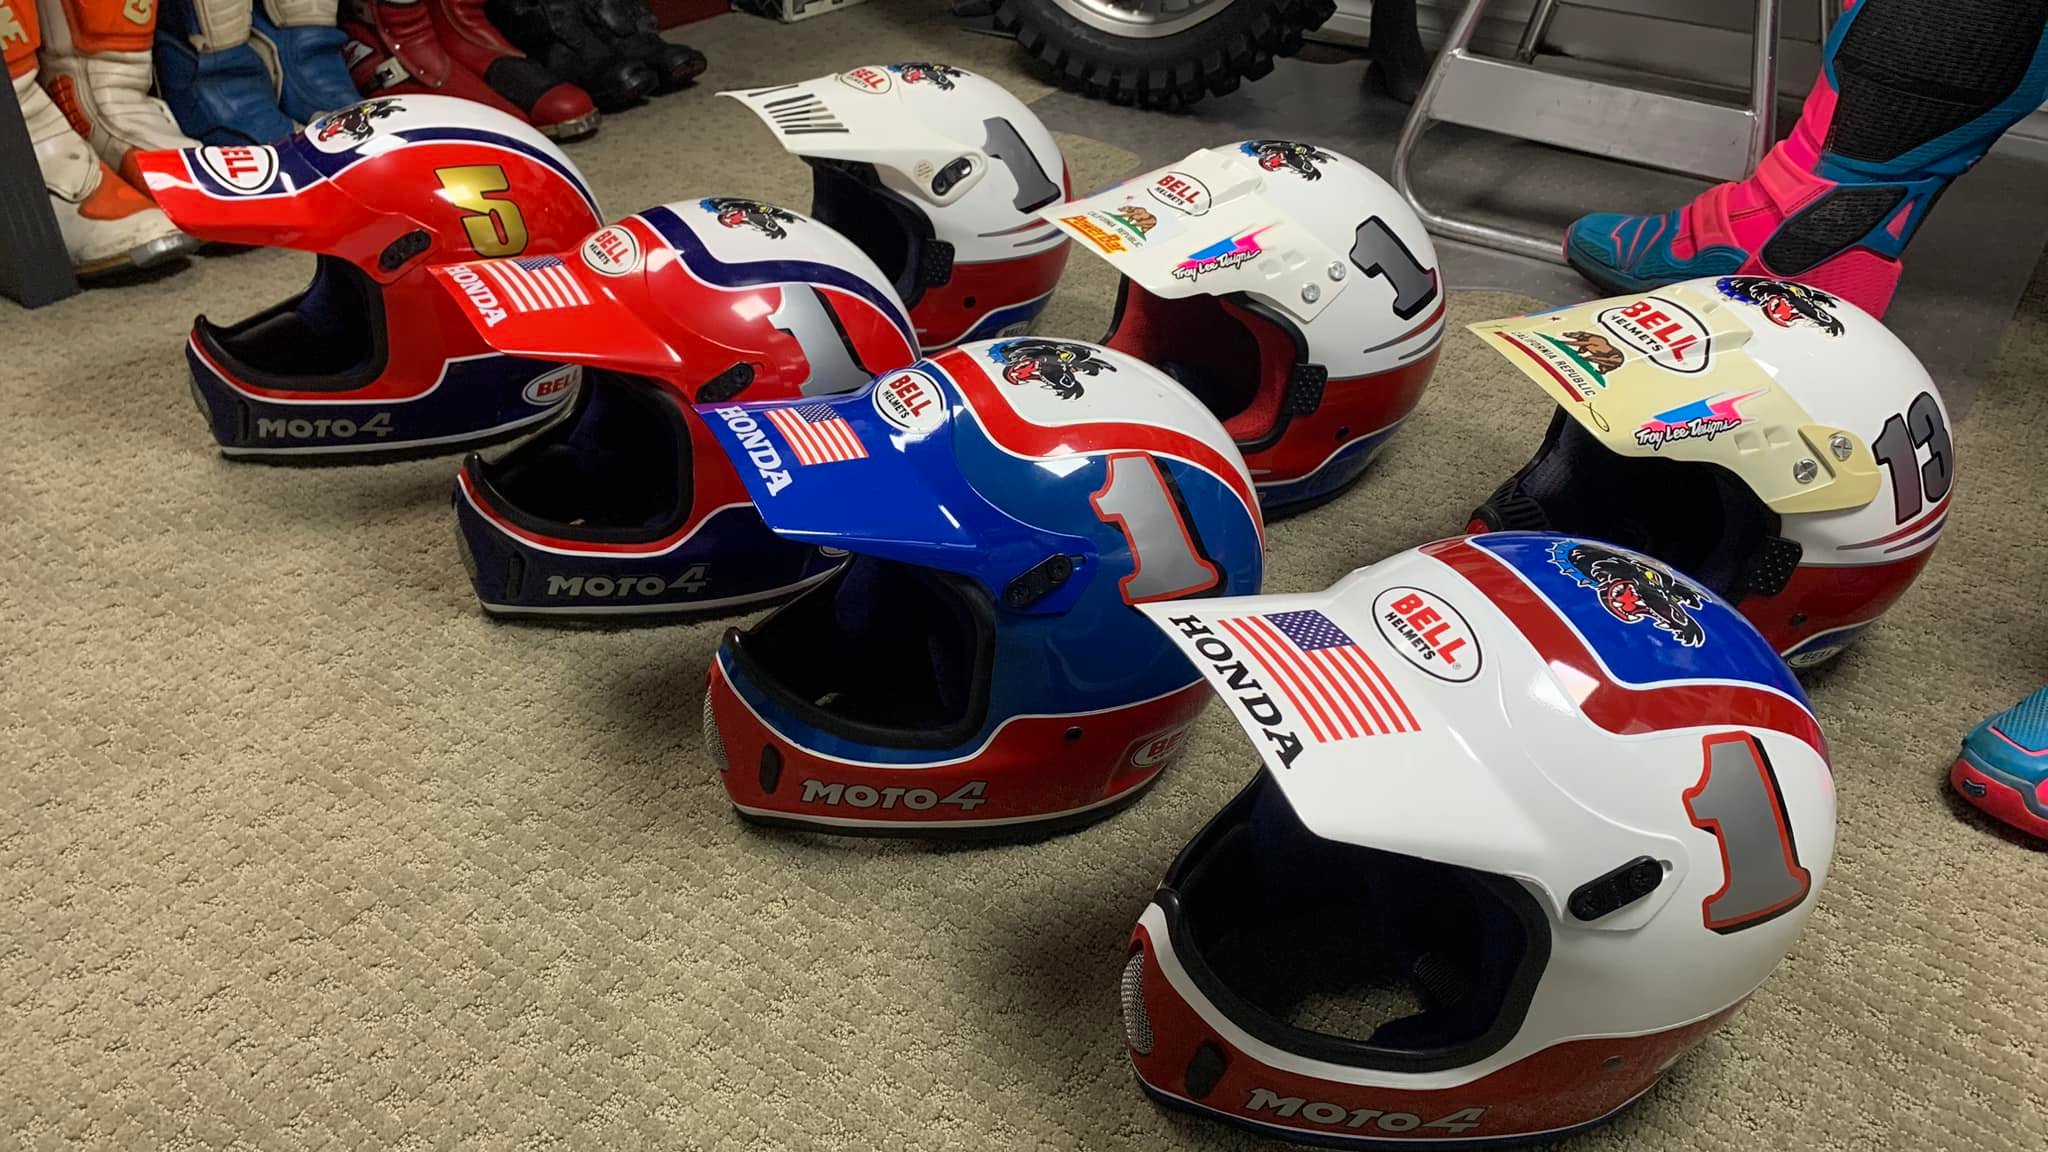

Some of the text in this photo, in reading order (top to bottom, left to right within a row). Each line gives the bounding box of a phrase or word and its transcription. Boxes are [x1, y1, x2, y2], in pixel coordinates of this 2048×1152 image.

[850, 68, 885, 88] BELL
[221, 147, 259, 178] ELL
[982, 116, 1061, 214] 1
[1157, 175, 1201, 204] BELL
[434, 164, 529, 257] 5
[1154, 186, 1186, 206] HELMETS
[595, 230, 629, 264] BELL
[1172, 249, 1262, 282] Troy Lee Designs
[1349, 215, 1438, 320] 1
[444, 264, 508, 328] HONDA
[768, 284, 875, 397] 1
[1610, 314, 1667, 352] HELMETS
[1621, 300, 1697, 363] BELL
[1511, 331, 1597, 397] CALIFORNIA REPUBLIC
[882, 389, 911, 419] HELMETS
[889, 375, 932, 418] BELL
[715, 406, 793, 497] HONDA
[1635, 417, 1742, 451] Troy Lee Designs
[1872, 391, 1953, 525] 13
[1089, 451, 1224, 605] 1
[1384, 611, 1436, 661] HELMETS
[1390, 593, 1467, 664] BELL
[1168, 614, 1304, 770] HONDA
[1682, 730, 1812, 935] 1
